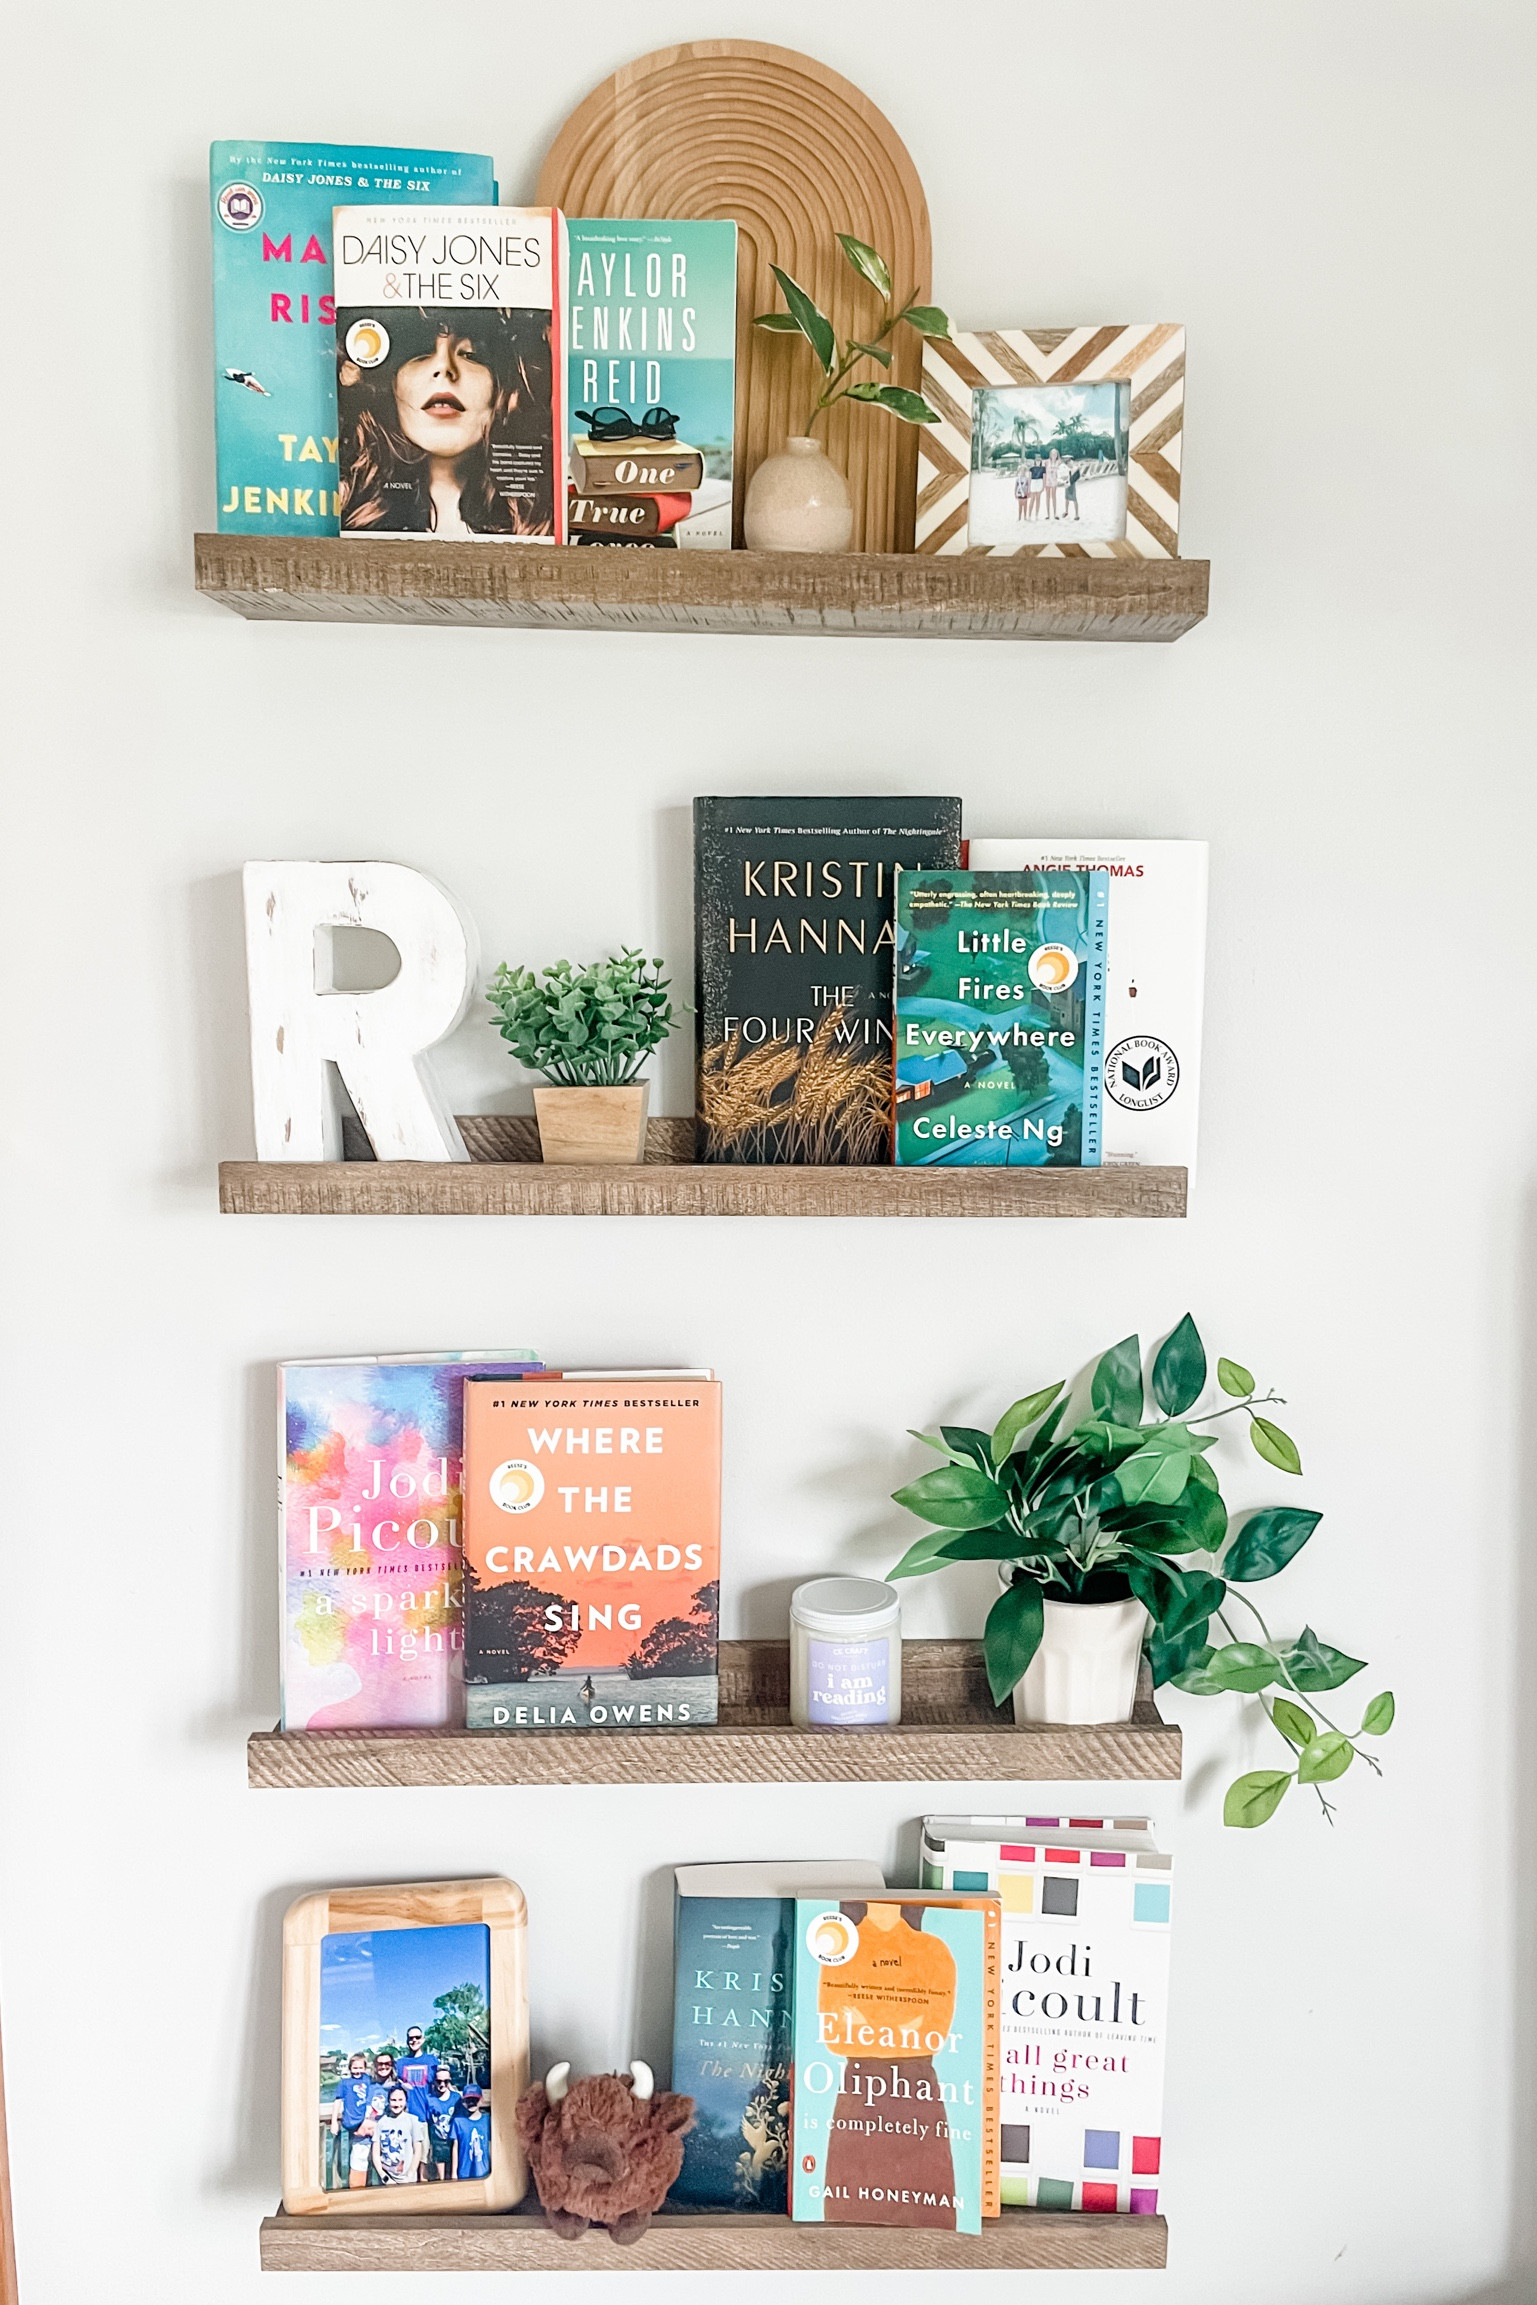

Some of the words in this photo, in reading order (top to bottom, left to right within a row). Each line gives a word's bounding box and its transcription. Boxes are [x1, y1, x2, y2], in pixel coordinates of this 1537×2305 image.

[229, 156, 241, 165] By
[246, 156, 262, 164] the
[266, 157, 286, 165] New
[291, 158, 312, 166] York
[317, 159, 347, 168] Times
[351, 161, 409, 174] bestselling
[413, 166, 447, 175] author
[262, 172, 303, 184] DAISY
[307, 174, 352, 187] JONES
[357, 176, 370, 188] &
[374, 178, 401, 190] THE
[406, 180, 430, 192] SIX
[262, 231, 327, 265] MA
[342, 234, 427, 265] DAISY
[432, 234, 541, 268] JONES
[460, 273, 500, 301] SIX
[577, 252, 687, 298] AYLOR
[572, 305, 696, 352] ENKINS
[583, 359, 661, 405] REID
[390, 482, 413, 490] NOVEL
[615, 460, 676, 485] One
[568, 499, 646, 525] True
[724, 826, 733, 834] #1
[735, 826, 753, 834] New
[754, 826, 771, 834] York
[773, 826, 796, 834] Times
[797, 826, 841, 836] Bestselling
[842, 827, 870, 835] Author
[871, 827, 881, 835] of
[882, 827, 897, 835] The
[898, 827, 943, 837] Nightingale
[744, 861, 921, 898] KRISTI
[993, 900, 1009, 908] York
[1011, 900, 1031, 908] Times
[957, 928, 1027, 953] Little
[1095, 919, 1104, 952] NEW
[957, 977, 1024, 1000] Fires
[1093, 962, 1103, 1001] YORK
[810, 985, 854, 1007] THE
[242, 860, 480, 1162] R
[724, 1016, 815, 1044] FOUR
[905, 1022, 1076, 1052] Everywhere
[1090, 1012, 1101, 1056] TIMES
[1107, 1042, 1133, 1089] NATIONAL
[1134, 1039, 1163, 1052] BOOK
[1161, 1051, 1176, 1087] AWARD
[977, 1081, 1016, 1090] NOVEL
[1088, 1067, 1099, 1154] BESTSELLER
[1119, 1092, 1164, 1108] LONGLIST
[912, 1115, 1019, 1139] Celeste
[1023, 1118, 1064, 1147] Ng
[492, 1400, 505, 1408] #1
[511, 1400, 539, 1408] NEW
[544, 1400, 578, 1408] YORK
[582, 1399, 619, 1408] TIMES
[624, 1399, 700, 1408] BESTSELLER
[526, 1426, 664, 1455] WHERE
[557, 1486, 633, 1513] THE
[320, 1568, 339, 1577] NEW
[346, 1566, 371, 1576] YORK
[378, 1564, 408, 1574] TIMES
[484, 1544, 703, 1574] CRAWDADS
[315, 1594, 334, 1616] a
[351, 1581, 463, 1620] spark
[543, 1603, 642, 1633] SING
[370, 1627, 464, 1662] light
[827, 1663, 848, 1672] NOT
[827, 1673, 834, 1689] i
[840, 1676, 873, 1690] am
[812, 1685, 887, 1706] reading
[493, 1705, 577, 1726] DELIA
[589, 1703, 691, 1724] OWENS
[880, 1955, 902, 1967] novel
[987, 1941, 996, 1976] NEW
[1008, 1940, 1093, 1978] Jodi
[694, 1970, 784, 1992] KRIS
[876, 1995, 929, 2005] WITHERSPOON
[986, 1988, 995, 2031] YORK
[816, 2012, 964, 2053] Eleanor
[1013, 2025, 1060, 2036] BESTSELLING
[1064, 2028, 1091, 2038] AUTHOR
[1107, 2033, 1136, 2042] LEAVING
[1140, 2035, 1157, 2044] TIME
[701, 2060, 732, 2078] The
[986, 2044, 994, 2093] TIMES
[1006, 2044, 1041, 2066] all
[1053, 2049, 1130, 2074] great
[803, 2061, 975, 2107] Oliphant
[1034, 2106, 1060, 2115] NOVEL
[803, 2113, 818, 2130] is
[826, 2115, 930, 2141] completely
[935, 2120, 972, 2141] fine
[985, 2106, 994, 2208] BESTSELLER
[808, 2185, 850, 2199] GAIL
[858, 2186, 965, 2210] HONEYMAN
